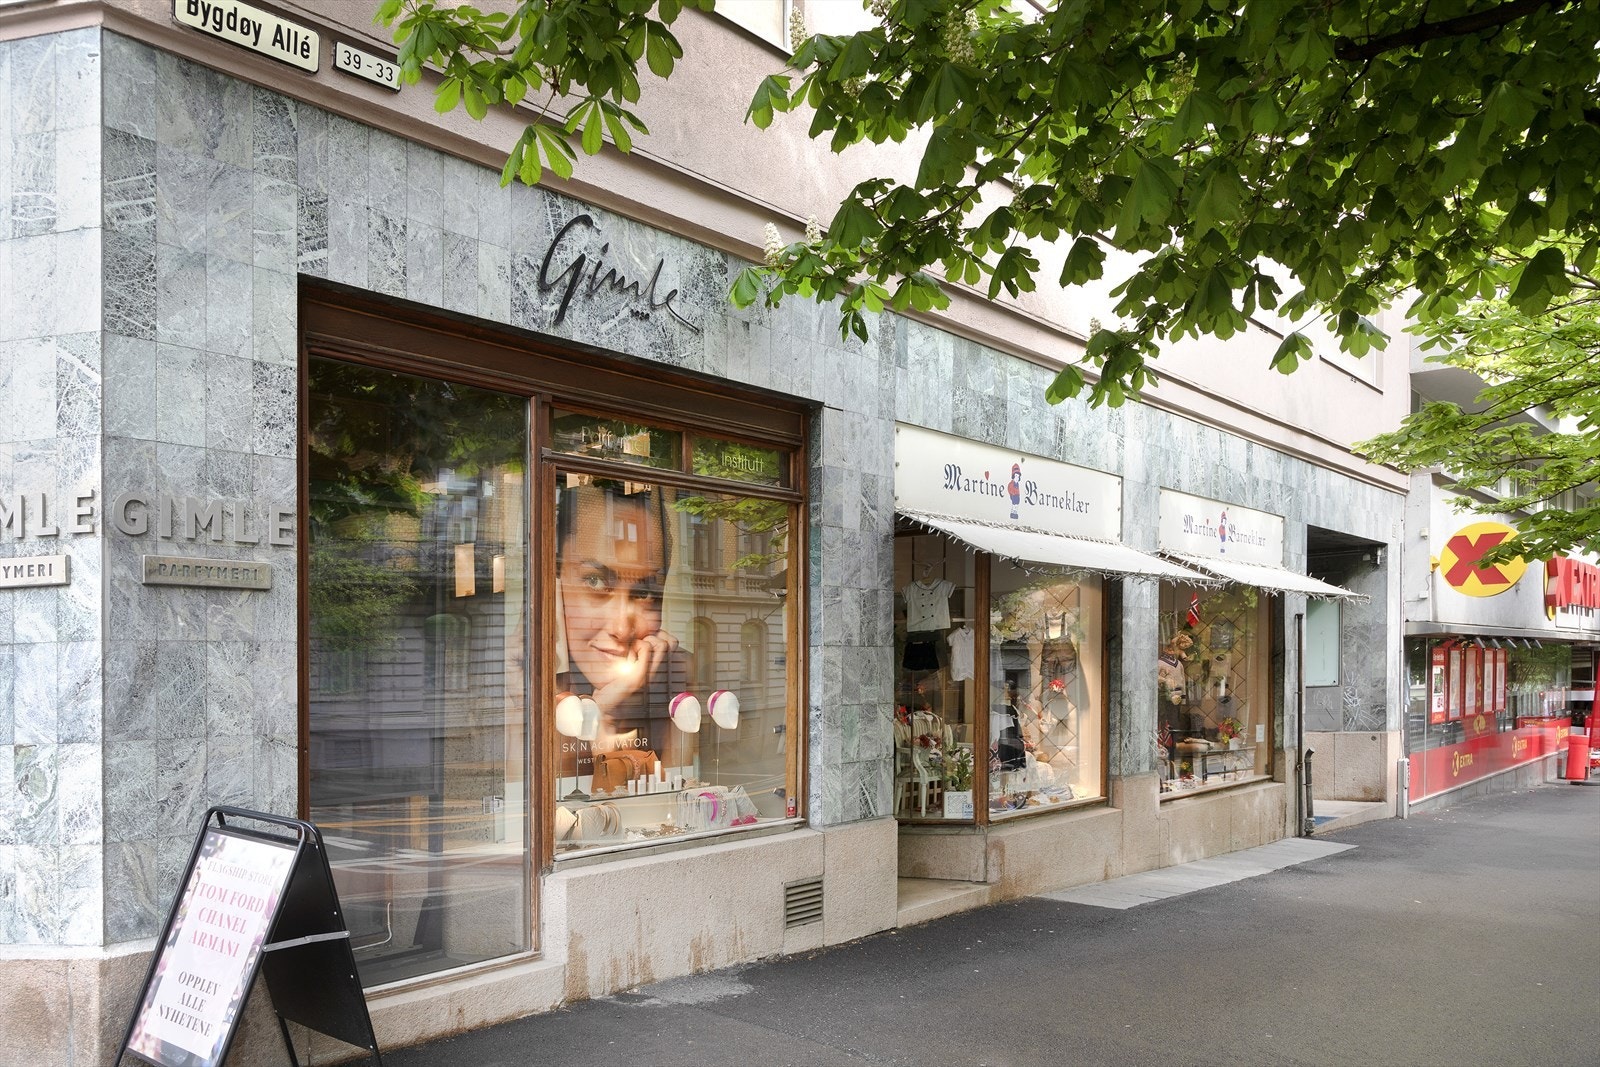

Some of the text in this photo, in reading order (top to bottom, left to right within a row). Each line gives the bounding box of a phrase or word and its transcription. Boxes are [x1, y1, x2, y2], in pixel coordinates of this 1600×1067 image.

[187, 0, 311, 59] Bygdøy Allé
[538, 214, 700, 335] Gimle
[943, 463, 1090, 514] Martine Barneklær
[113, 491, 294, 546] GIMLE
[1183, 514, 1267, 547] Martine Barneklær
[158, 563, 259, 582] PARFYMERI
[207, 861, 274, 887] FLAGSHIP STORE
[198, 882, 265, 913] TOM FORD
[198, 906, 247, 935] CHANEL
[189, 929, 240, 958] ARMANI
[178, 970, 221, 996] OPPLEV
[177, 992, 206, 1013] ALLE
[156, 1003, 213, 1038] NYHETENE
